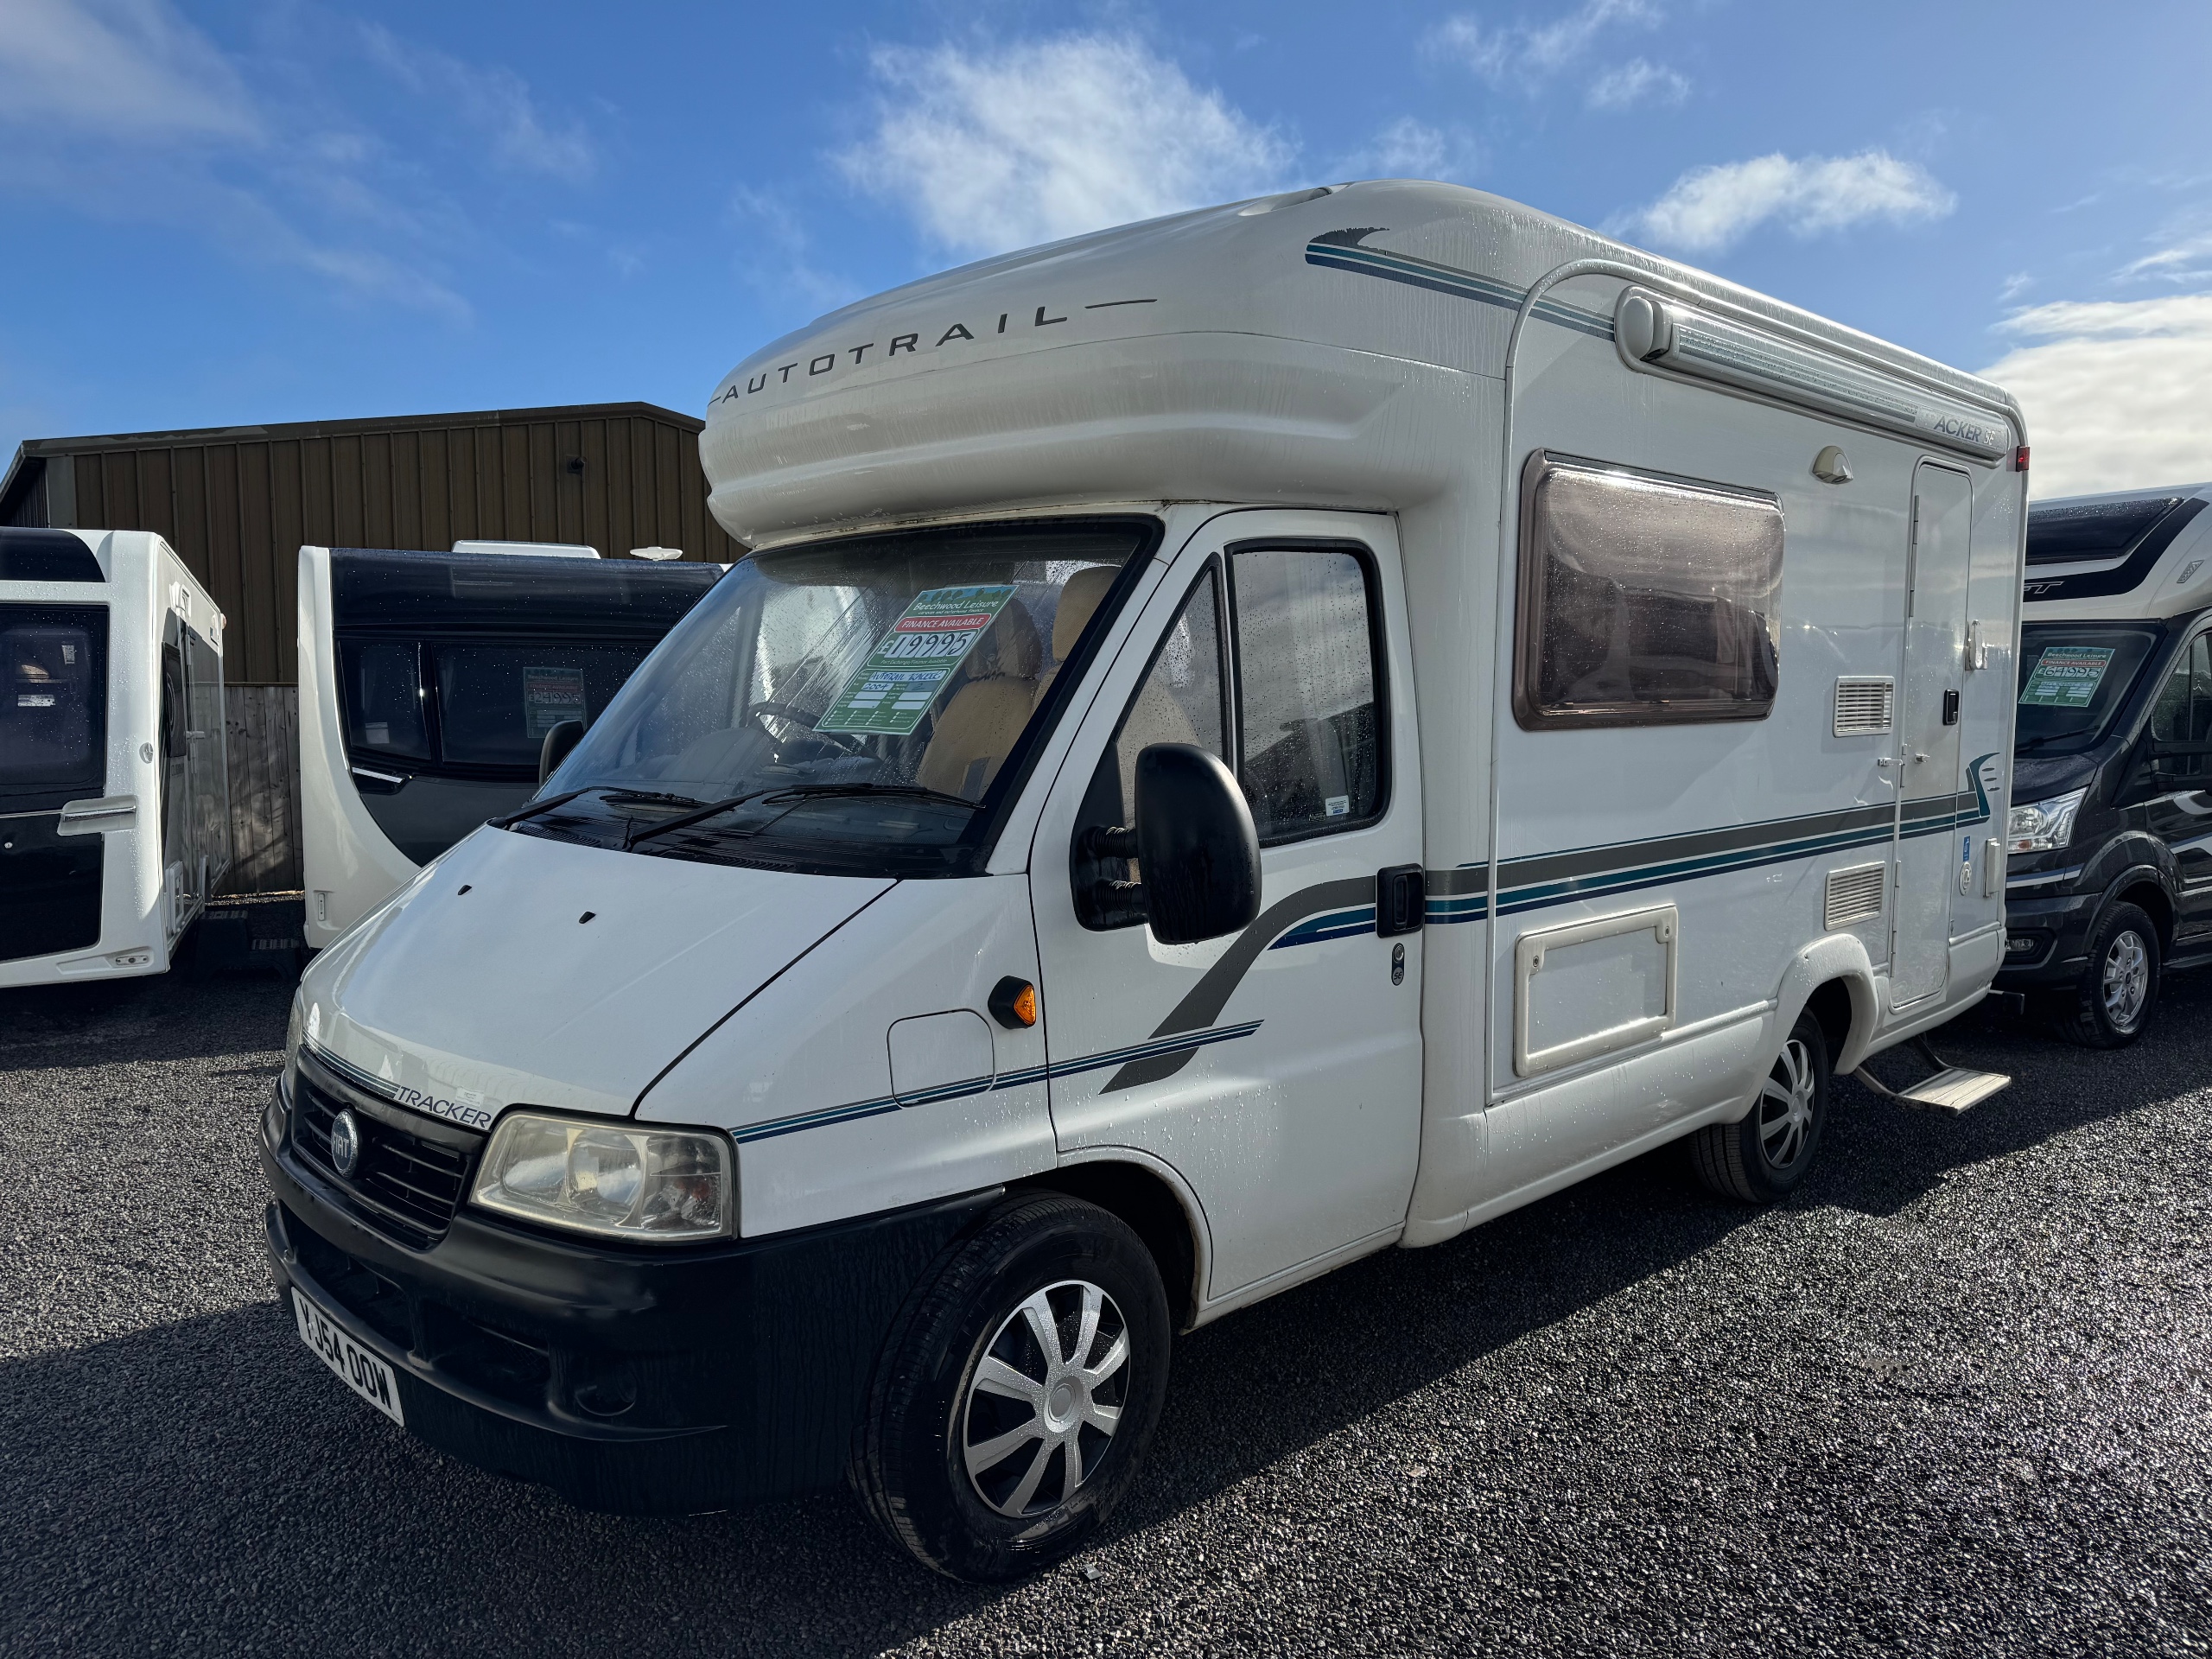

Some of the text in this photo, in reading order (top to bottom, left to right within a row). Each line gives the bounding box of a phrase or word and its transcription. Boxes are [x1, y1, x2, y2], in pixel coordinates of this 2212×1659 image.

[722, 306, 1068, 404] AUTOTRAIL
[913, 600, 999, 611] Beechwood Leisure
[938, 617, 985, 627] AVAILABLE
[912, 683, 925, 691] 2
[398, 1086, 492, 1128] TRACKER
[299, 1298, 346, 1374] YJ54
